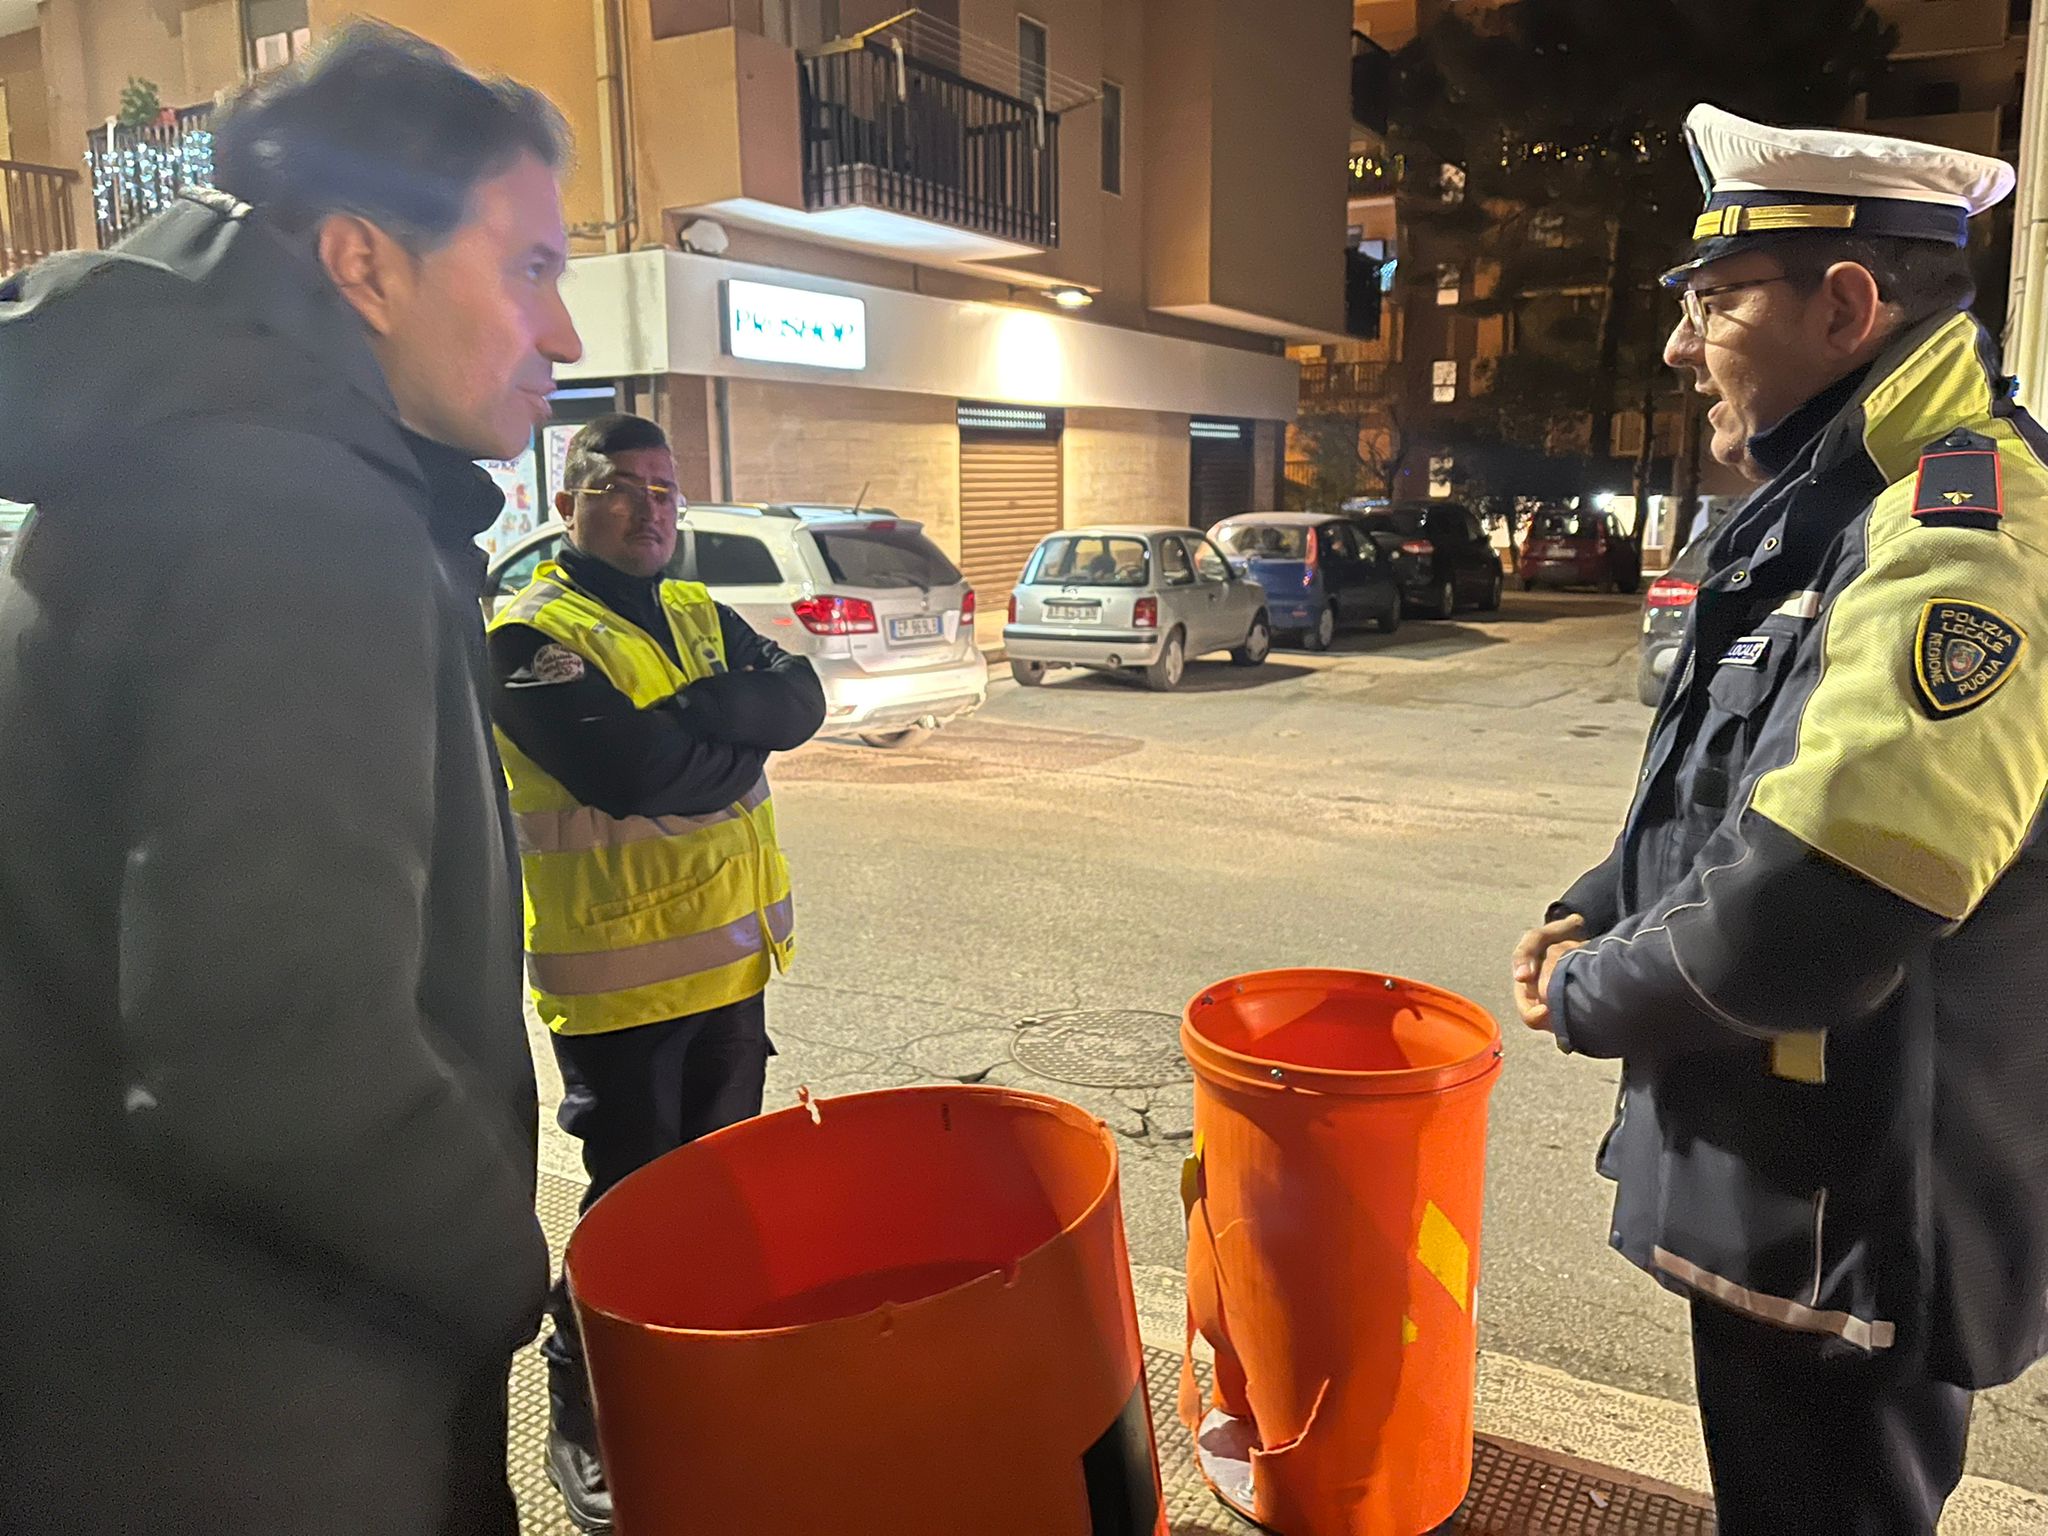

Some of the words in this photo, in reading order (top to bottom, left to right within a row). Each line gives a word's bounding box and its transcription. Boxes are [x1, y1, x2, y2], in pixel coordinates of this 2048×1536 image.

[1941, 609, 2013, 646] POLIZIA
[1942, 622, 2004, 654] LOCALE
[1958, 659, 2006, 695] PUGLIA
